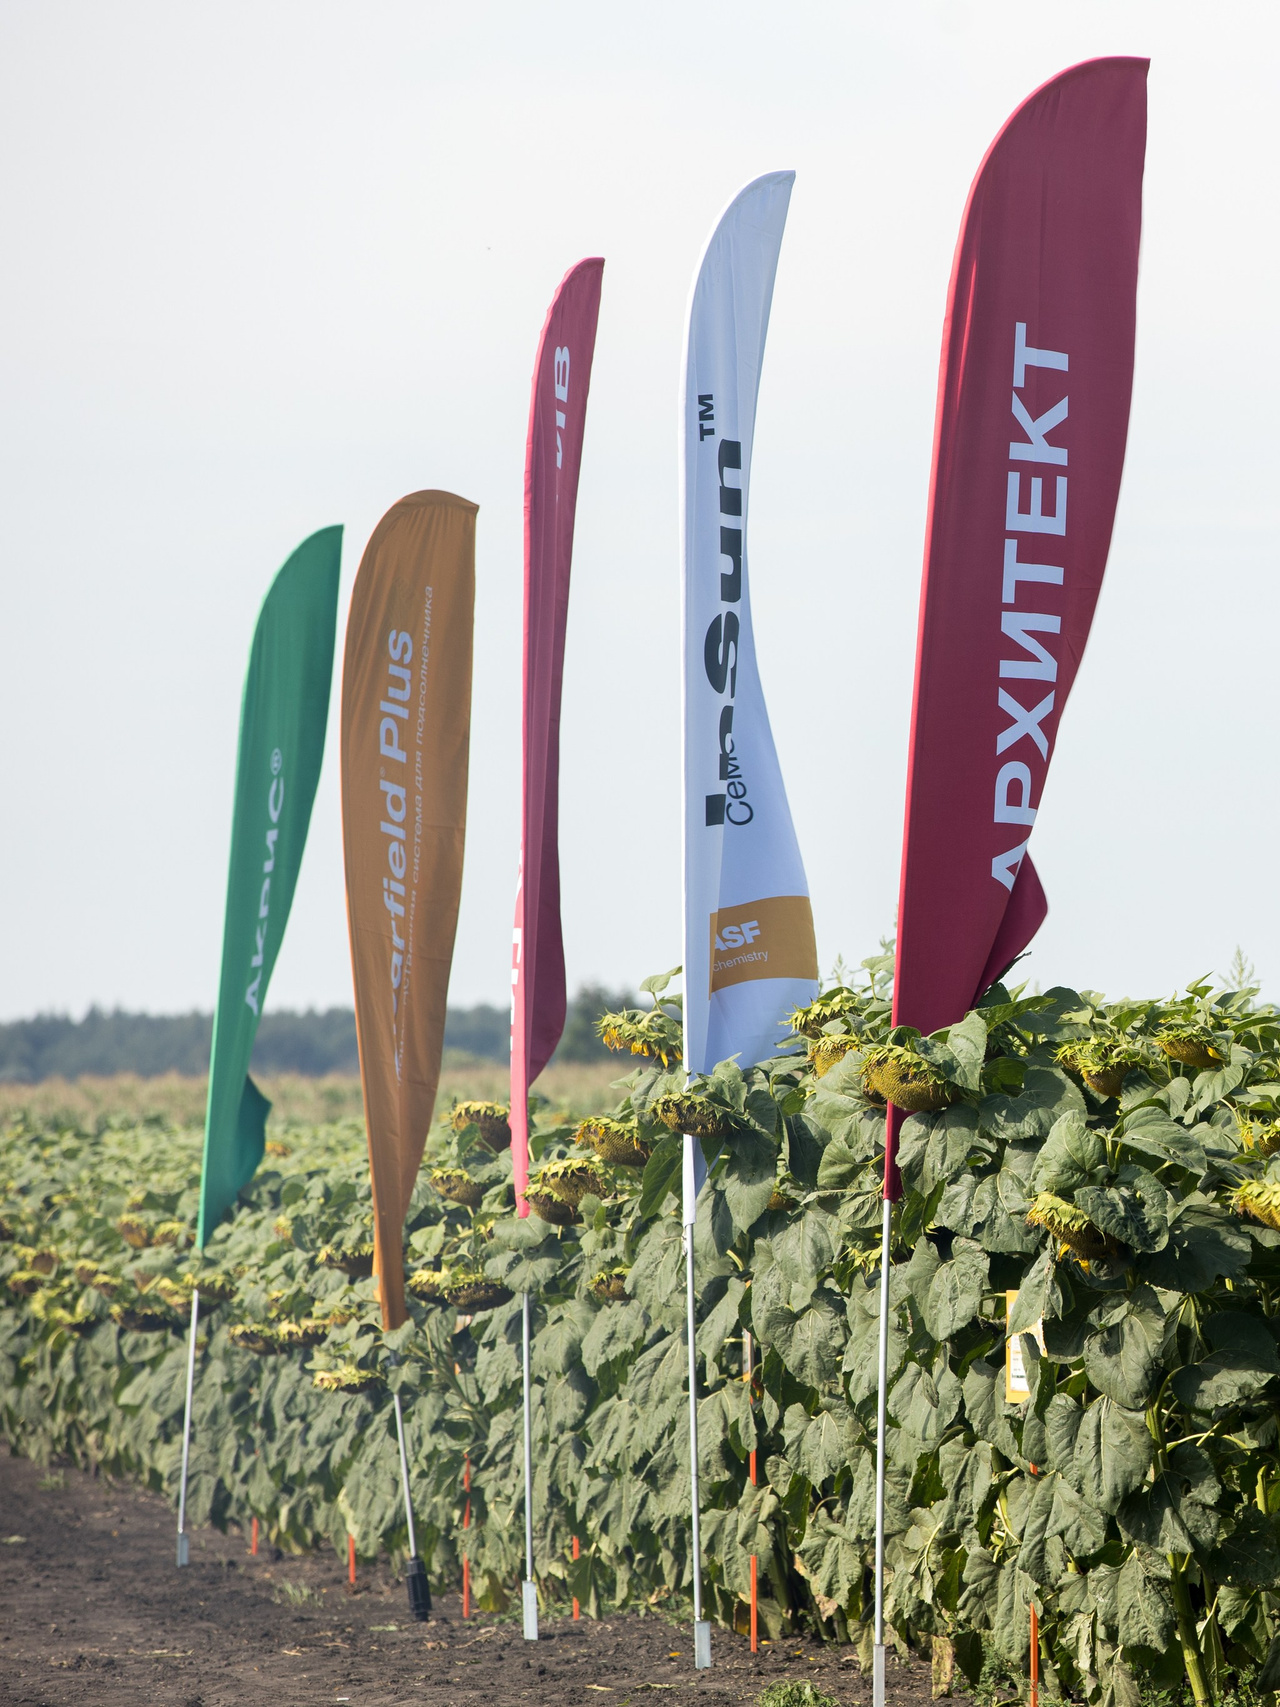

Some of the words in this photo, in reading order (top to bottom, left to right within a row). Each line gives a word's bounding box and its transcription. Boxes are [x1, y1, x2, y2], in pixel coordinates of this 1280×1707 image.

[990, 322, 1070, 893] АРХИТЕКТ
[379, 629, 414, 764] Plus
[415, 586, 433, 745] подсолнечника
[414, 751, 423, 792] для
[412, 794, 423, 884] система
[712, 951, 769, 972] chemistry
